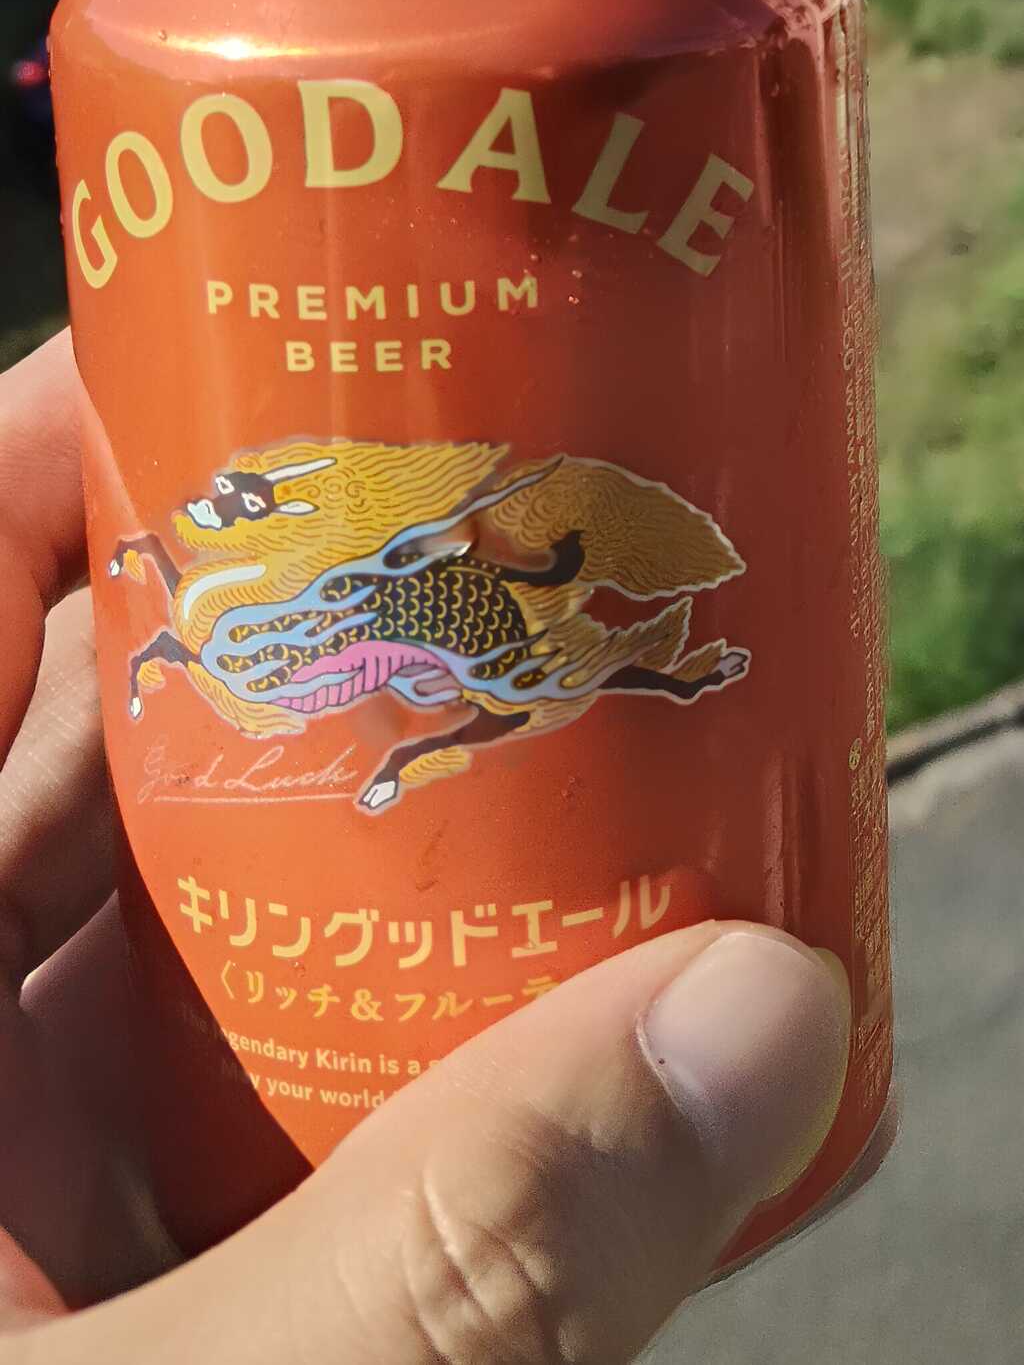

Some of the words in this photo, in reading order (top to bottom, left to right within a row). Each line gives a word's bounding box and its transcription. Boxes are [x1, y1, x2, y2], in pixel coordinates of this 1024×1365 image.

[72, 79, 403, 289] GOOD
[436, 87, 755, 277] ALE
[207, 277, 540, 321] PREMIUM
[286, 337, 454, 373] BEER
[224, 734, 358, 792] Luck
[177, 874, 672, 969] キリングッドエール
[315, 1046, 372, 1074] Kirin
[379, 1053, 400, 1075] is
[407, 1060, 421, 1075] a
[265, 1076, 313, 1100] your
[319, 1087, 385, 1109] world
